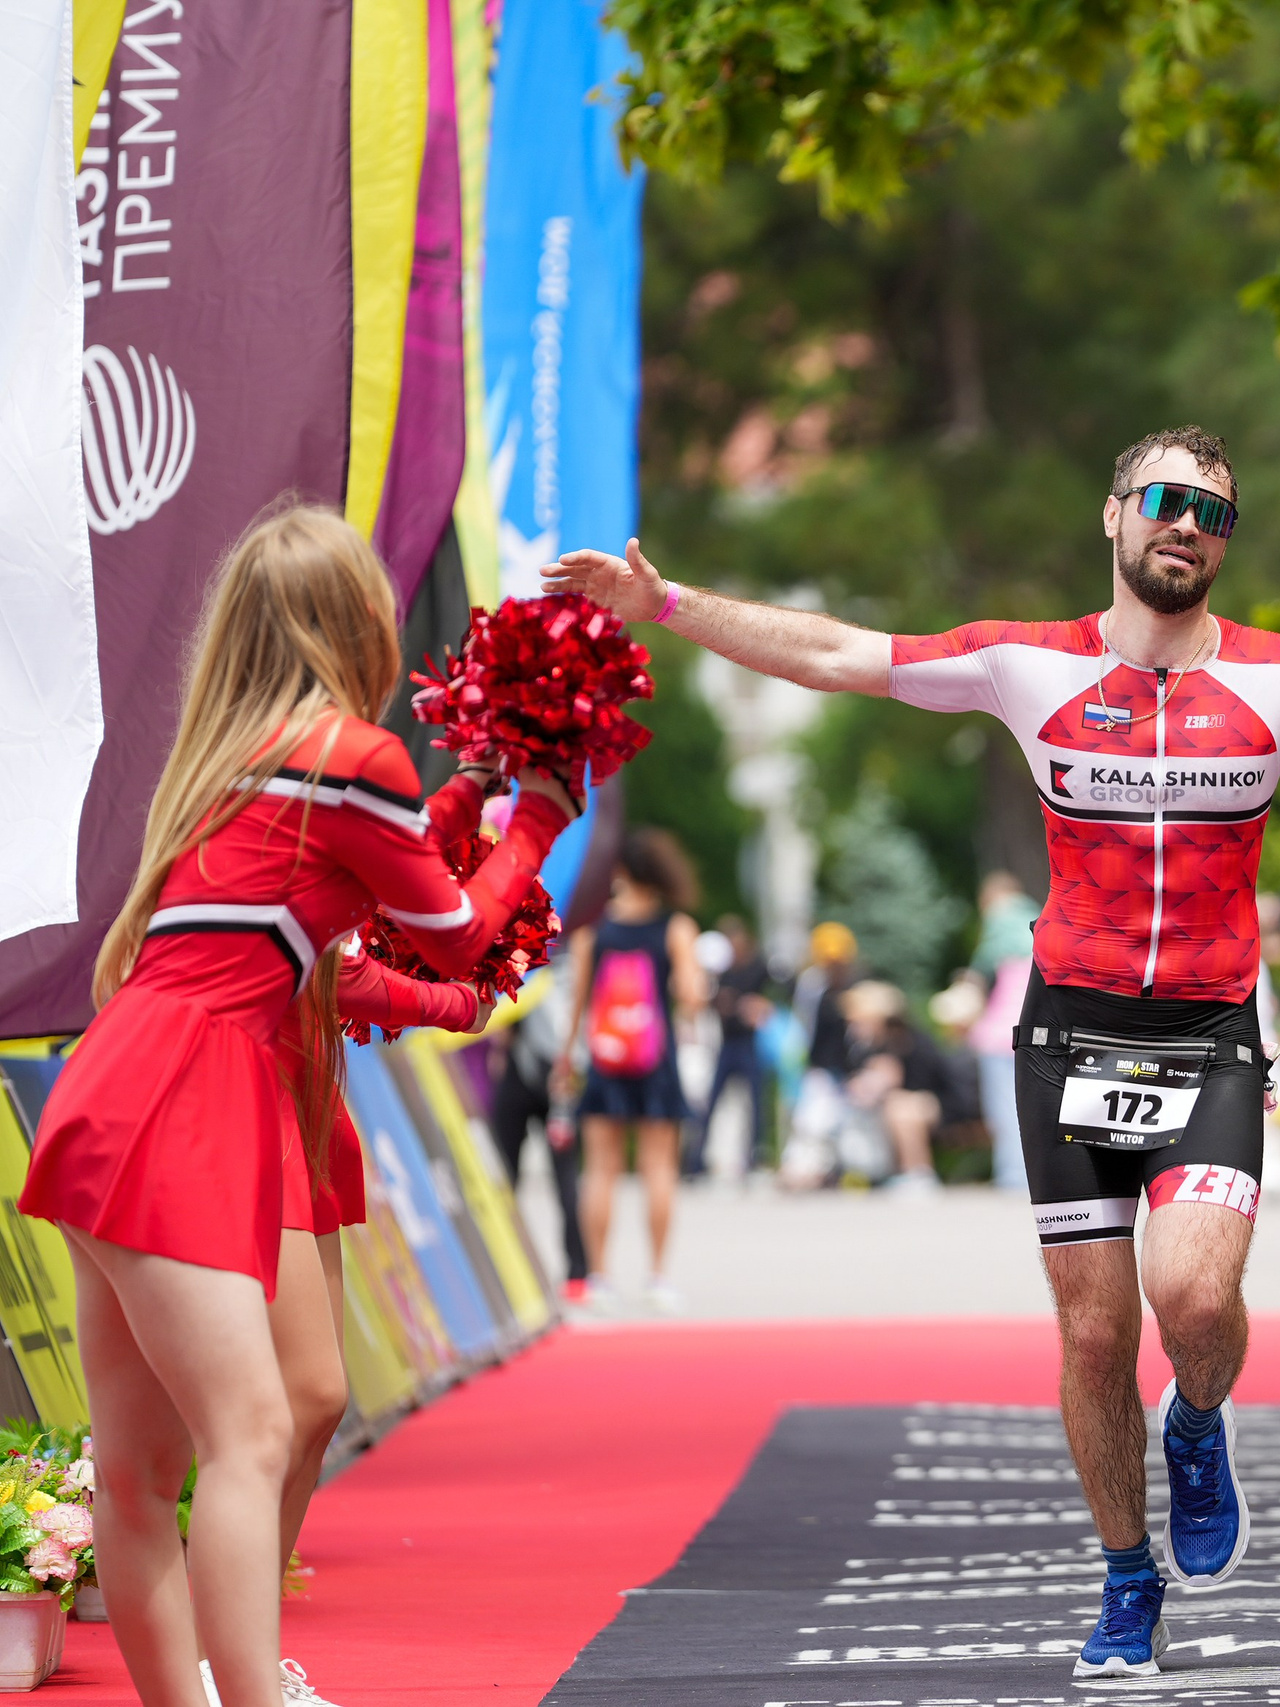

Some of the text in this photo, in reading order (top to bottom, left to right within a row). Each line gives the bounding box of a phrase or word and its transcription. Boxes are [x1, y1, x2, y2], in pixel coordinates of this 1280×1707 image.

[1090, 768, 1266, 787] KALASHNIKOV
[1116, 1060, 1160, 1072] IRON STAR
[1174, 1070, 1199, 1078] МАГНИТ
[1103, 1090, 1163, 1125] 172
[1110, 1132, 1145, 1145] VIKTOR
